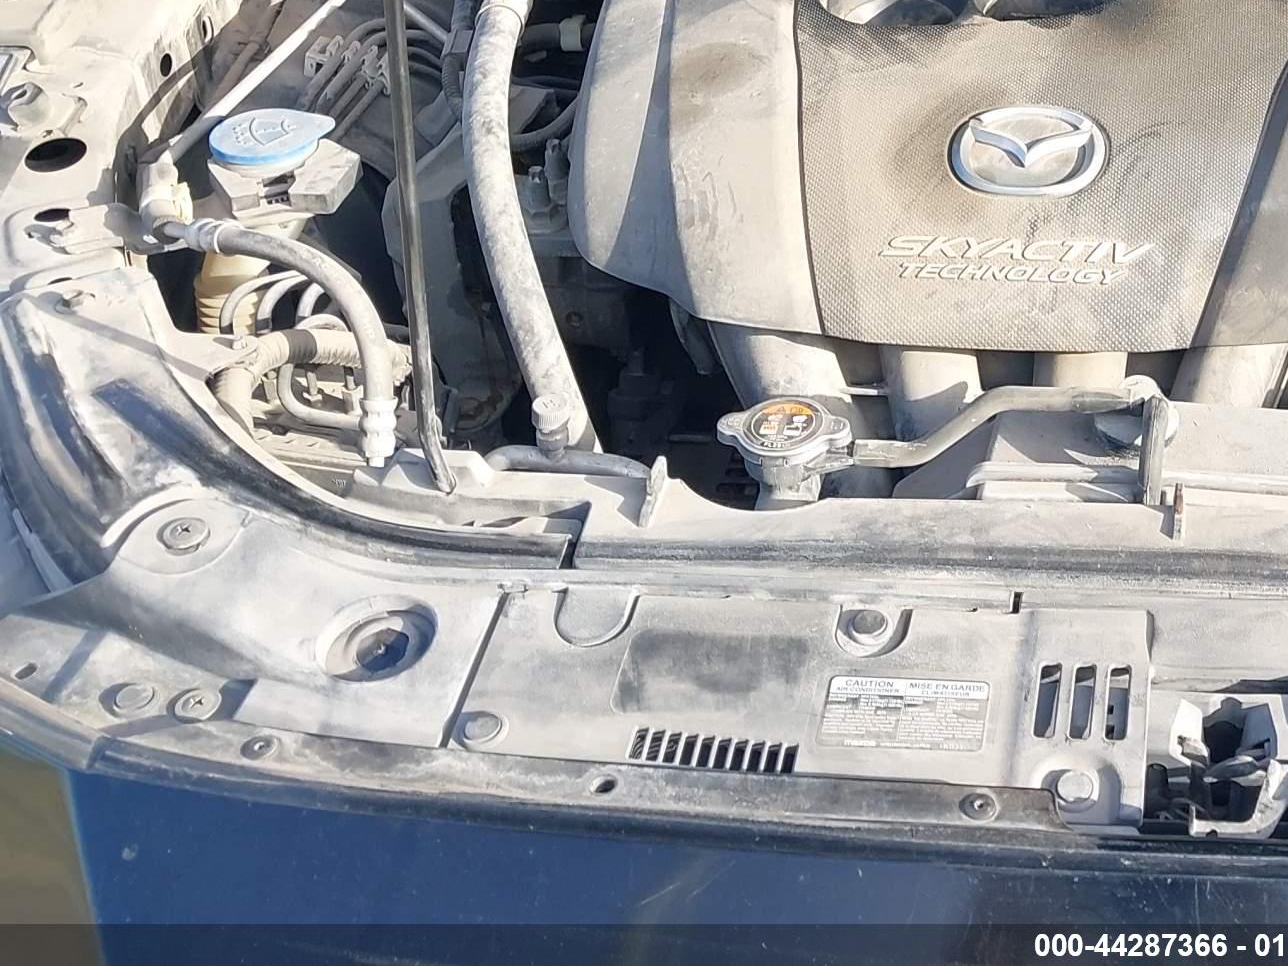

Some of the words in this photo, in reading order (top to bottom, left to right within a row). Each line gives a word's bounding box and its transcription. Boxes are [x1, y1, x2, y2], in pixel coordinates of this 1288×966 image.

[878, 234, 1156, 265] SKYACTIV
[897, 261, 1127, 286] TECHNOLOGY
[845, 679, 894, 688] CAUTION
[909, 682, 933, 690] MISE
[935, 683, 949, 691] EN
[950, 684, 985, 692] GARDE
